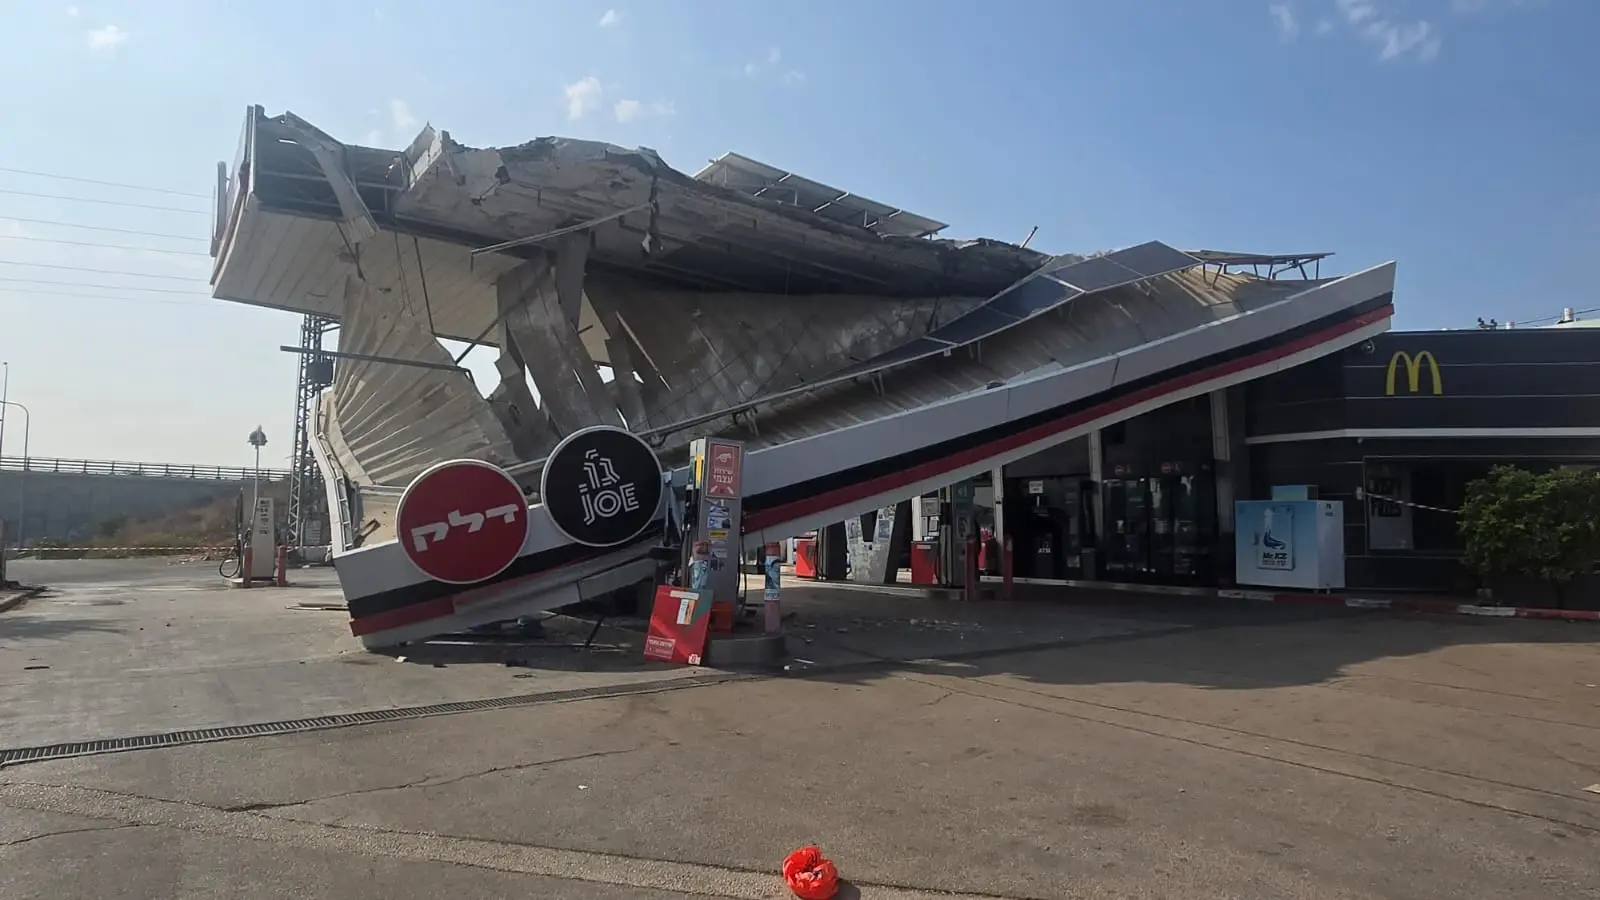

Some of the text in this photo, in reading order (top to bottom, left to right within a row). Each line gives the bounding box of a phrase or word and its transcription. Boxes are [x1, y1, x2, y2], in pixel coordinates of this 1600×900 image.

[713, 475, 733, 484] עצמי
[578, 482, 639, 526] JOE
[411, 504, 519, 552] דלק
